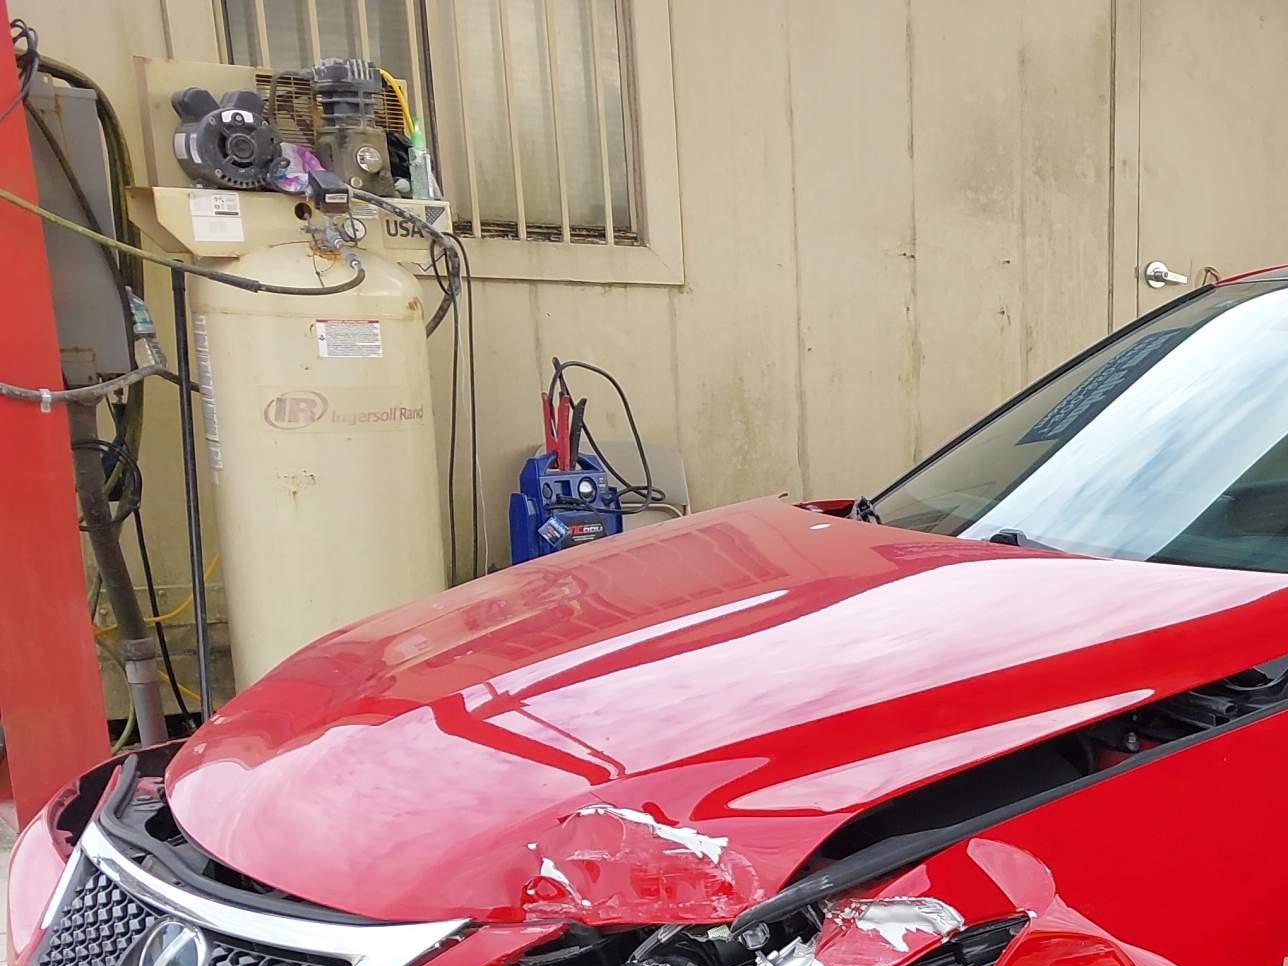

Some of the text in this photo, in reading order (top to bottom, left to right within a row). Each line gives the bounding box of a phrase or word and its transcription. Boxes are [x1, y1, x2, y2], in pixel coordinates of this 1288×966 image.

[385, 219, 424, 238] USA
[331, 404, 423, 425] Ingersoll Rand
